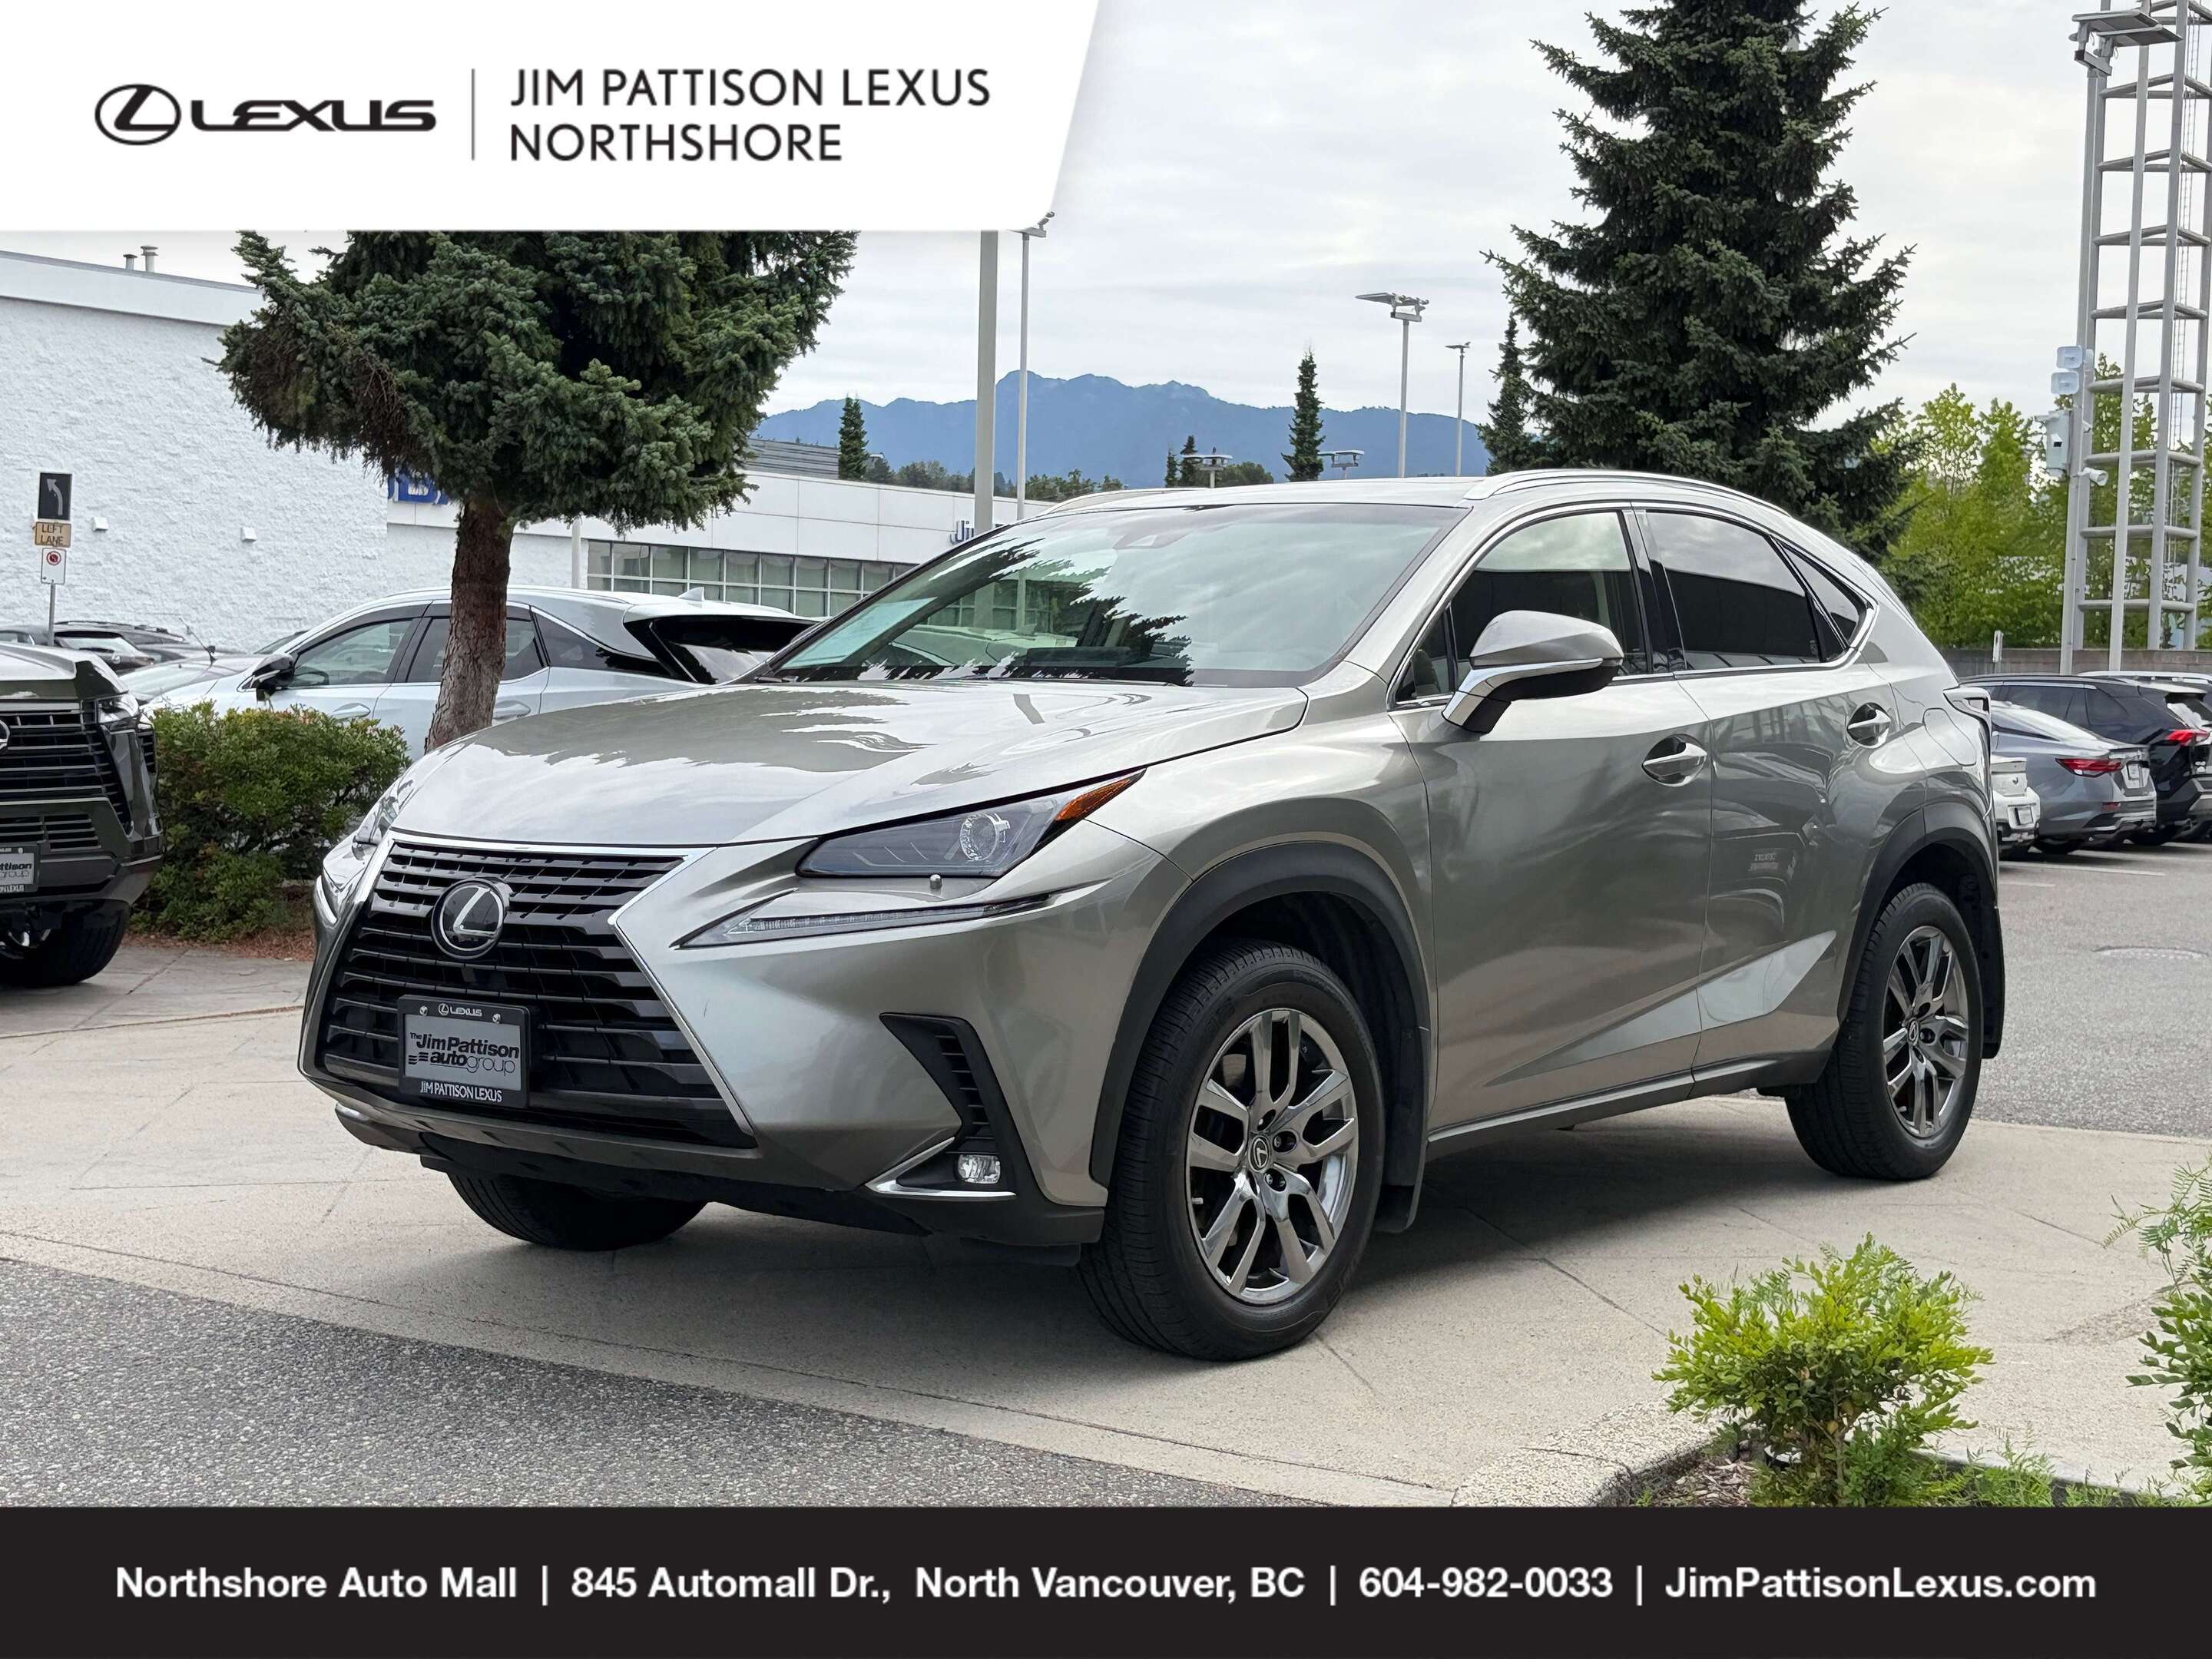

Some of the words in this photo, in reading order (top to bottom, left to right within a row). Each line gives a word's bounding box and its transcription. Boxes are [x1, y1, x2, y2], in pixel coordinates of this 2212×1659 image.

[40, 535, 64, 546] LANE
[450, 1006, 483, 1017] LEXUS
[416, 1034, 446, 1050] Jim
[447, 1037, 520, 1059] Pattison
[420, 1081, 433, 1094] JIM
[434, 1082, 475, 1100] PATTISON
[475, 1088, 503, 1103] LEXUS
